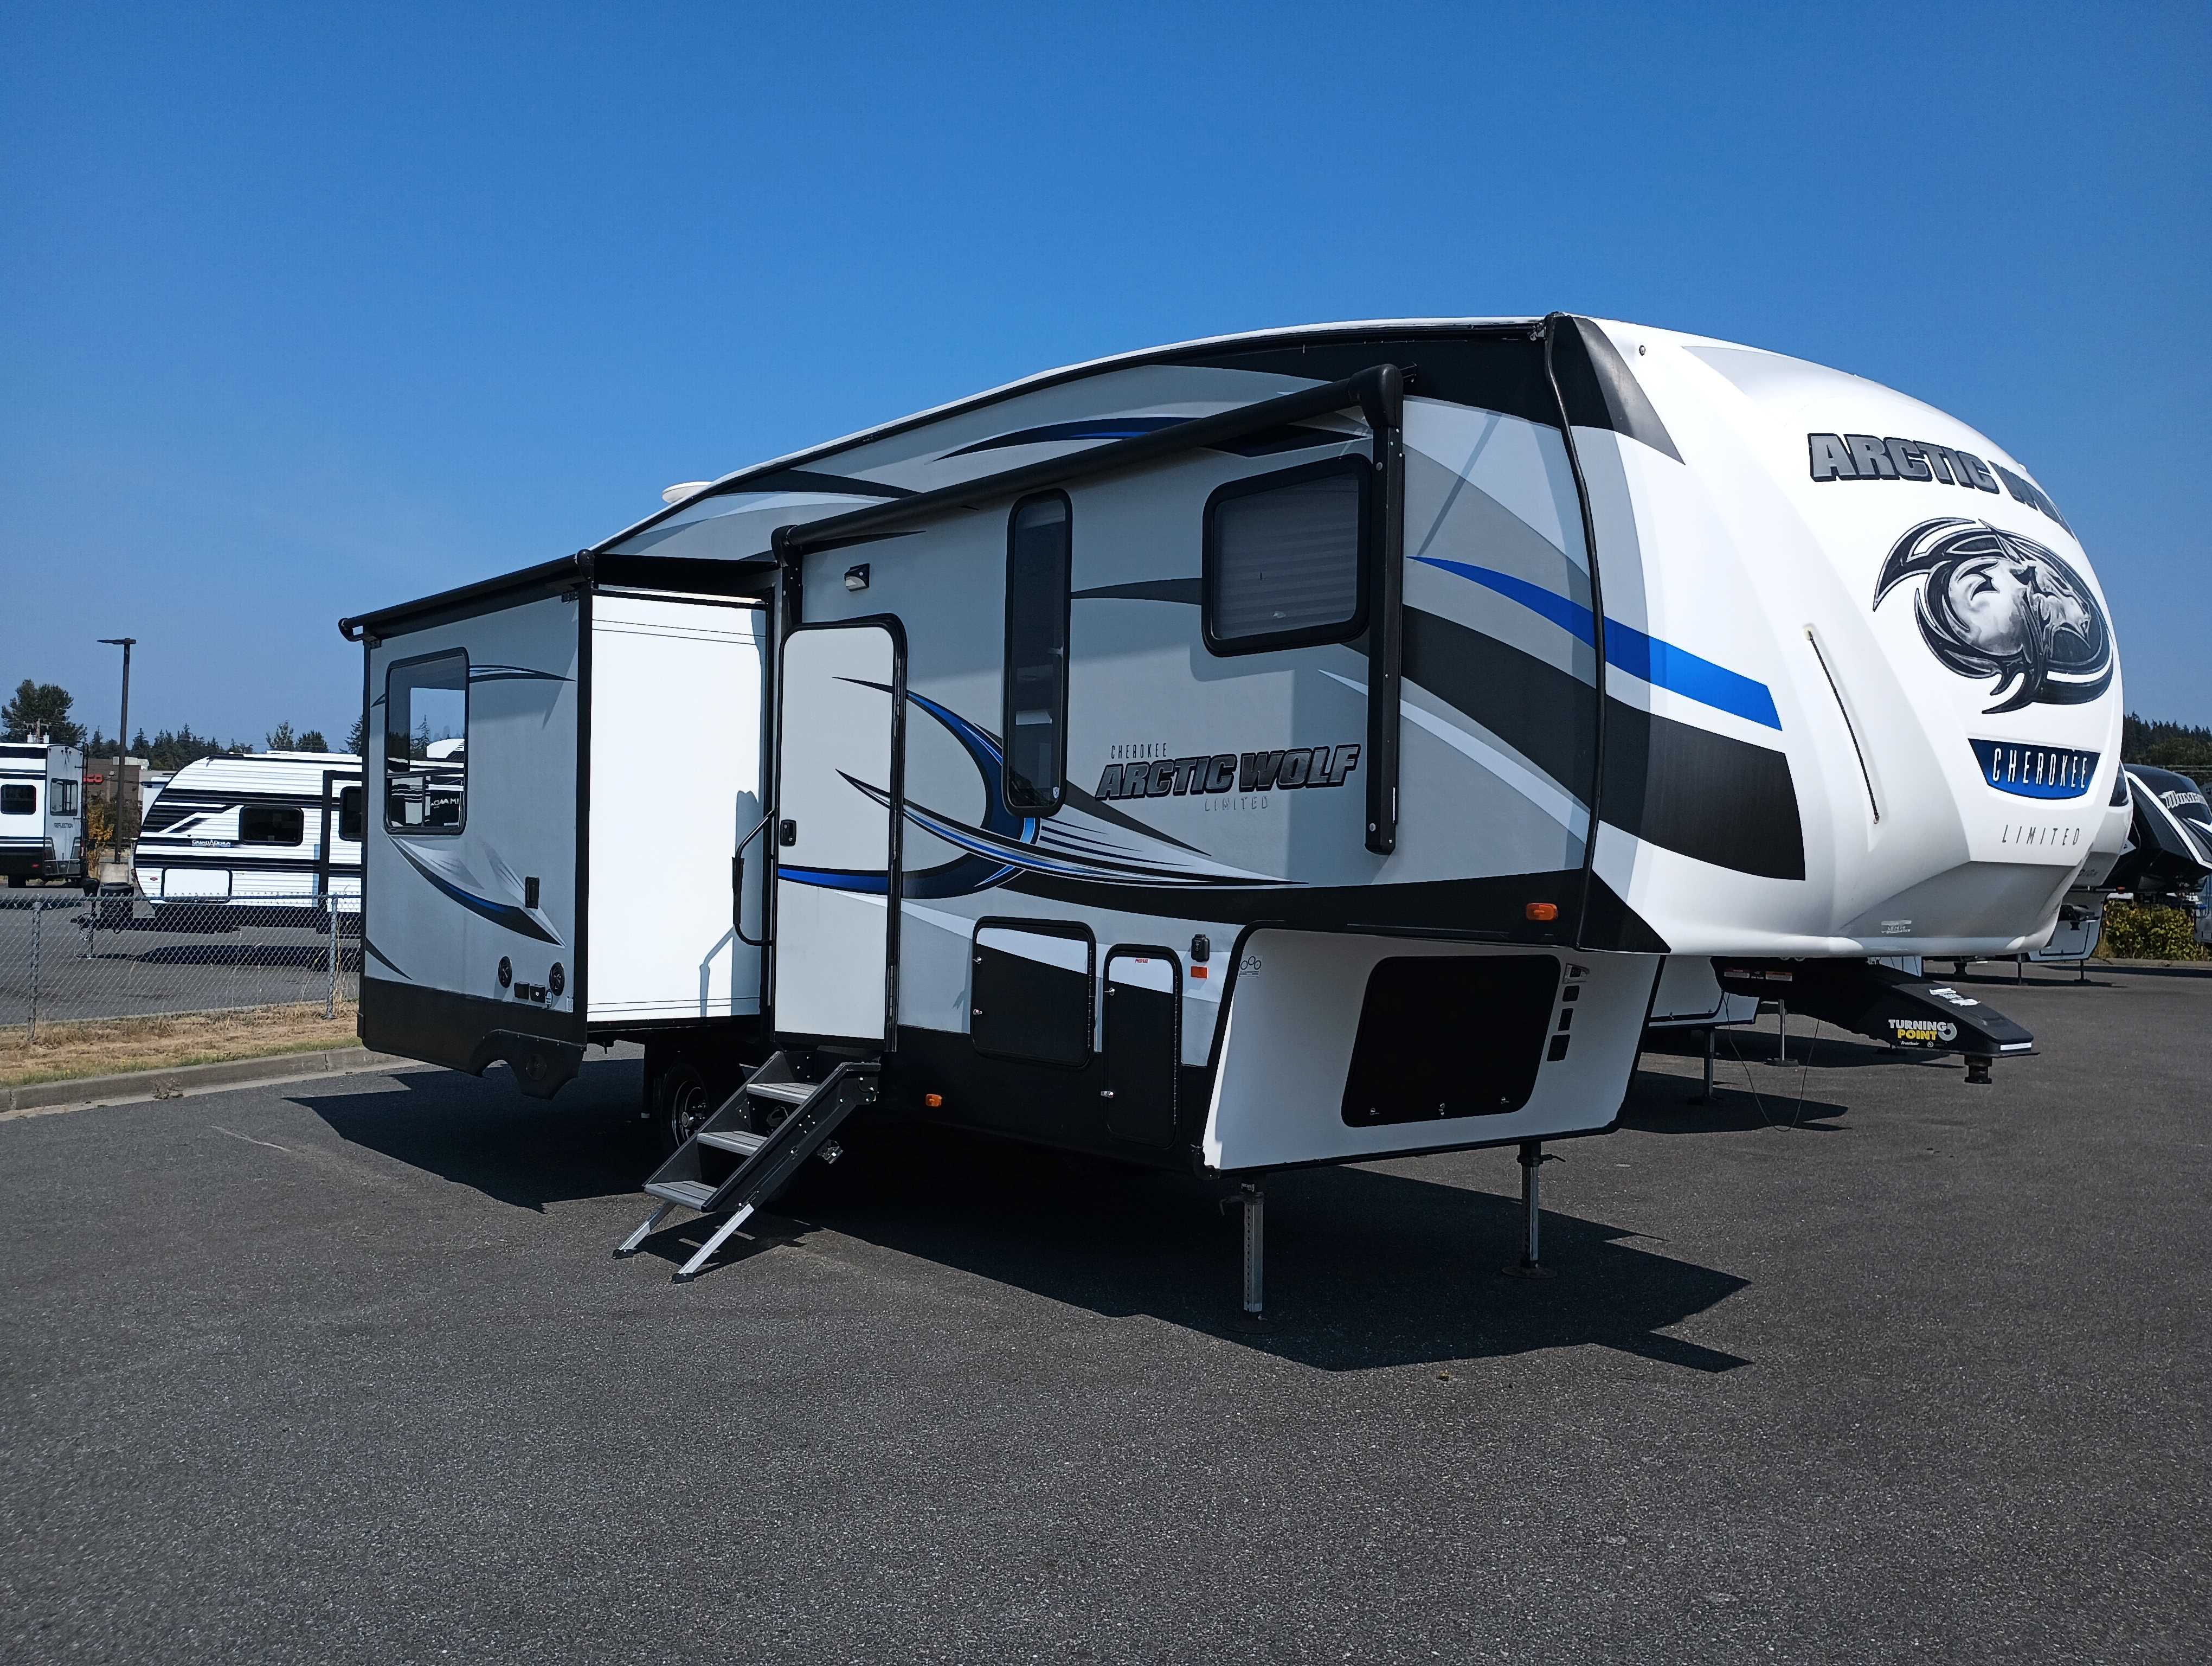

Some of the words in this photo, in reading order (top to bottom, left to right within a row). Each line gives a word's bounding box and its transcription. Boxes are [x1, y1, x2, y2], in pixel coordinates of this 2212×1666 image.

[1808, 433, 2000, 495] ARCTIC
[1111, 742, 1167, 759] CHEROKEE
[1095, 753, 1238, 800] ARCTIC
[1239, 744, 1361, 792] WOLF
[1992, 748, 2087, 789] CHEROKEE
[1205, 796, 1269, 812] LIMITED
[2002, 824, 2080, 846] LIMITED
[1888, 1019, 1947, 1031] TURNING
[1898, 1029, 1938, 1041] POINT
